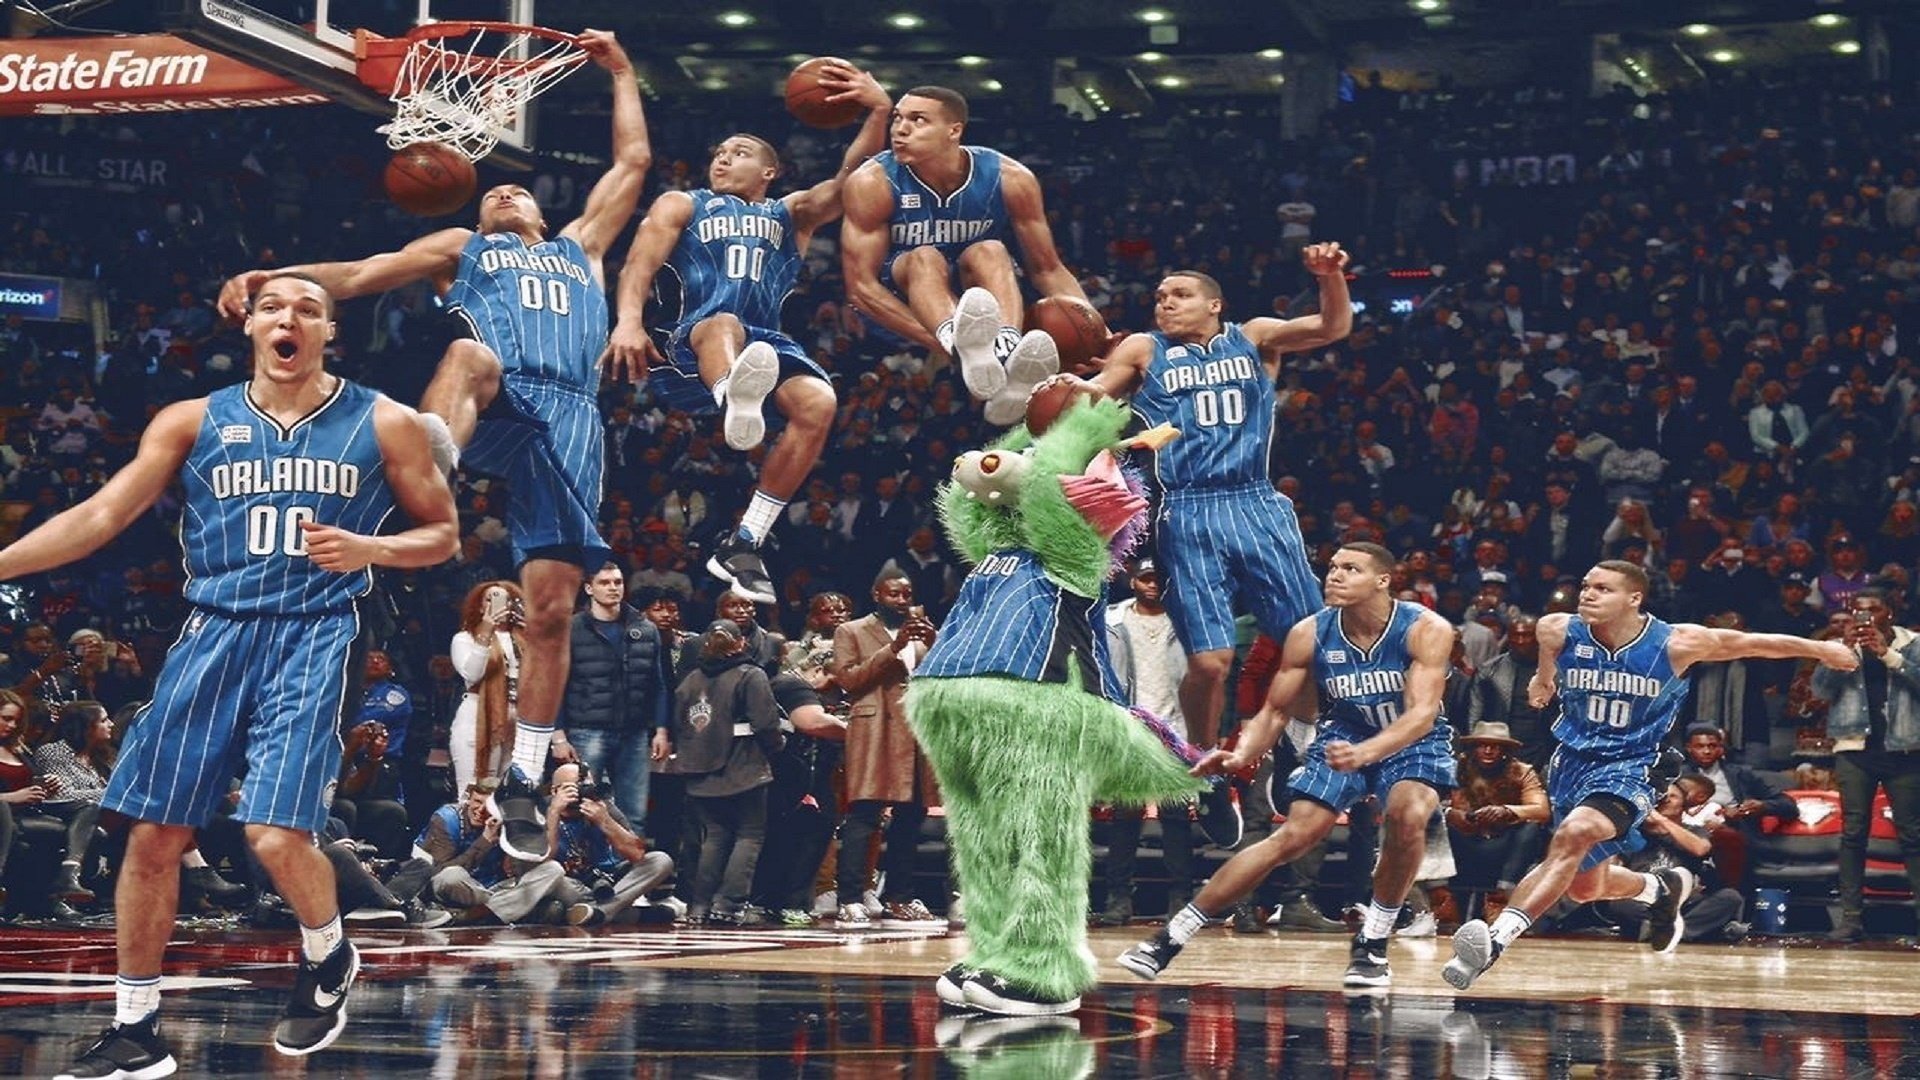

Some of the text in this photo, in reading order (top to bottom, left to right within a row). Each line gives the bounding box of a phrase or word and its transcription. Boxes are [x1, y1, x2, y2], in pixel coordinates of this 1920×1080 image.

[98, 158, 168, 186] STAR
[481, 248, 589, 288] ORLANDO
[727, 243, 766, 283] 00
[520, 273, 570, 316] 00
[1163, 356, 1258, 394] ORLAND
[1196, 388, 1245, 427] 00
[211, 457, 360, 500] ORLANDO
[248, 505, 315, 556] 00
[1325, 670, 1406, 699] ORLAND
[1566, 668, 1660, 698] ORLANDO
[1587, 695, 1630, 728] 00
